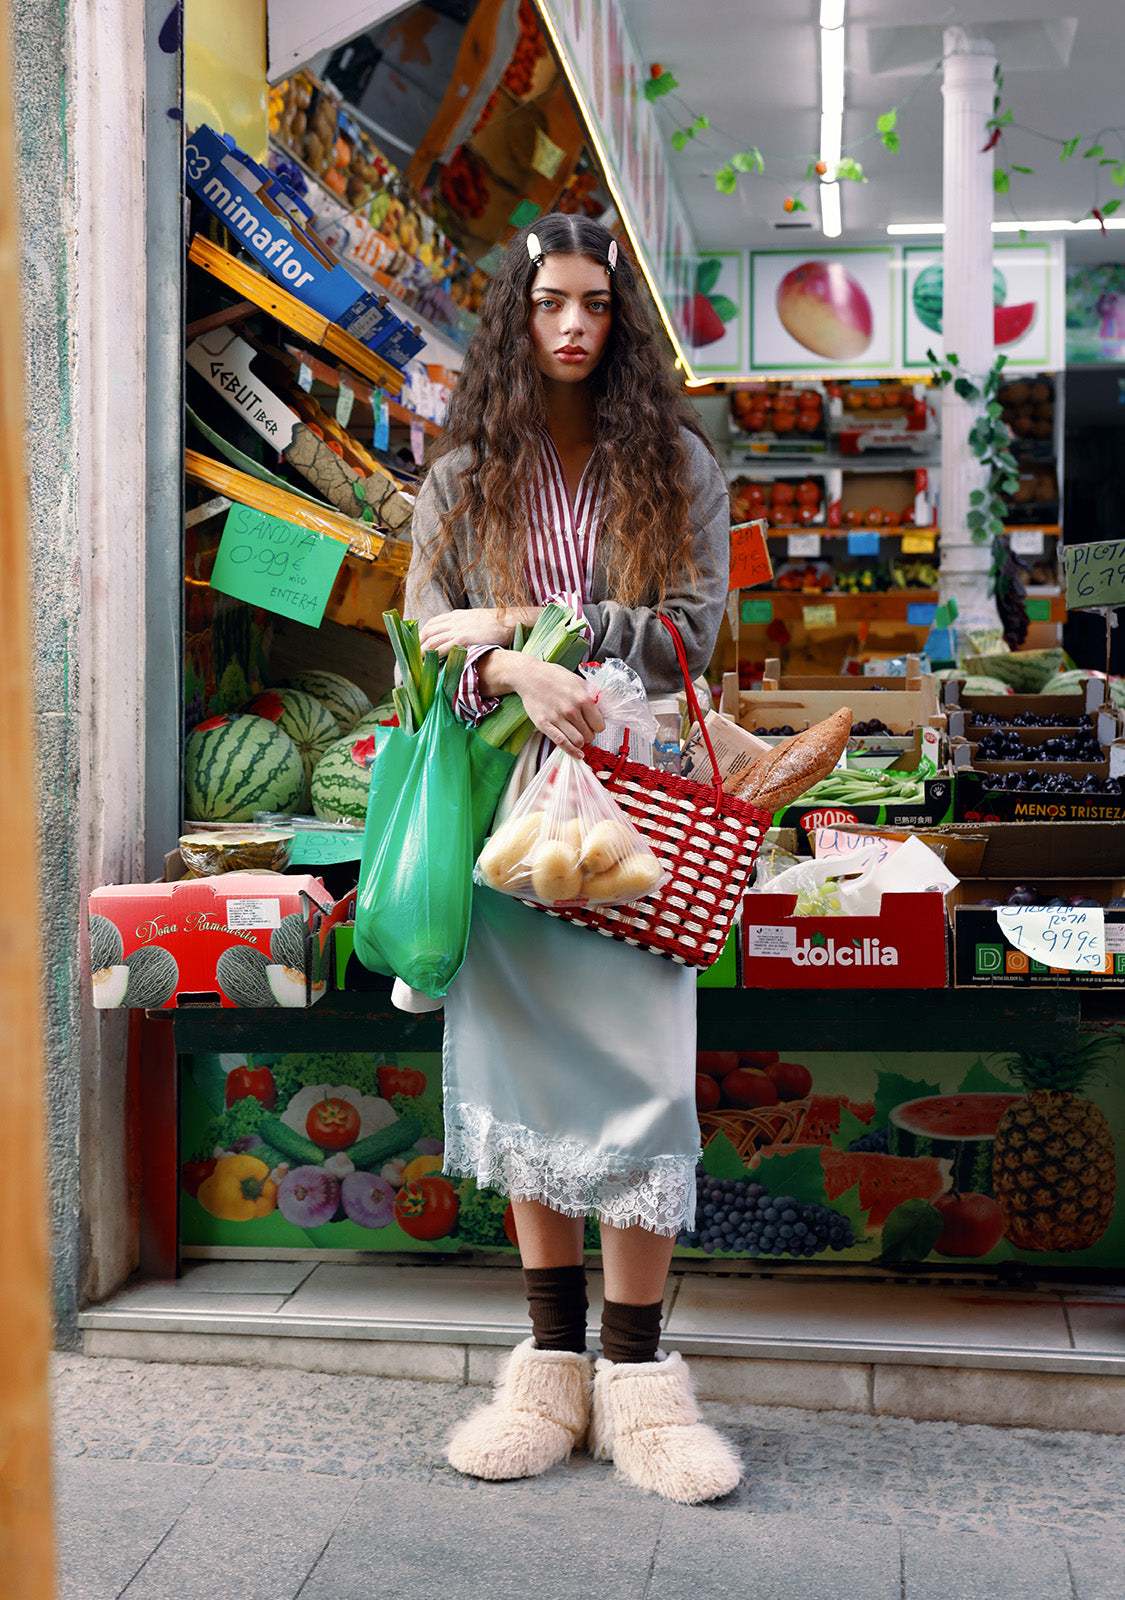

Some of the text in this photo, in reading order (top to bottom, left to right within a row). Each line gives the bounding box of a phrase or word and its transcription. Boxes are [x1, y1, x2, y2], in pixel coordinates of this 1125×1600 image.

[203, 177, 315, 288] mimaflor
[253, 408, 278, 435] IBER
[234, 509, 318, 553] SANDIA
[269, 587, 318, 612] ENTERA
[1014, 803, 1067, 817] MENOS
[135, 914, 178, 945] Doña
[791, 937, 899, 967] dolcilia
